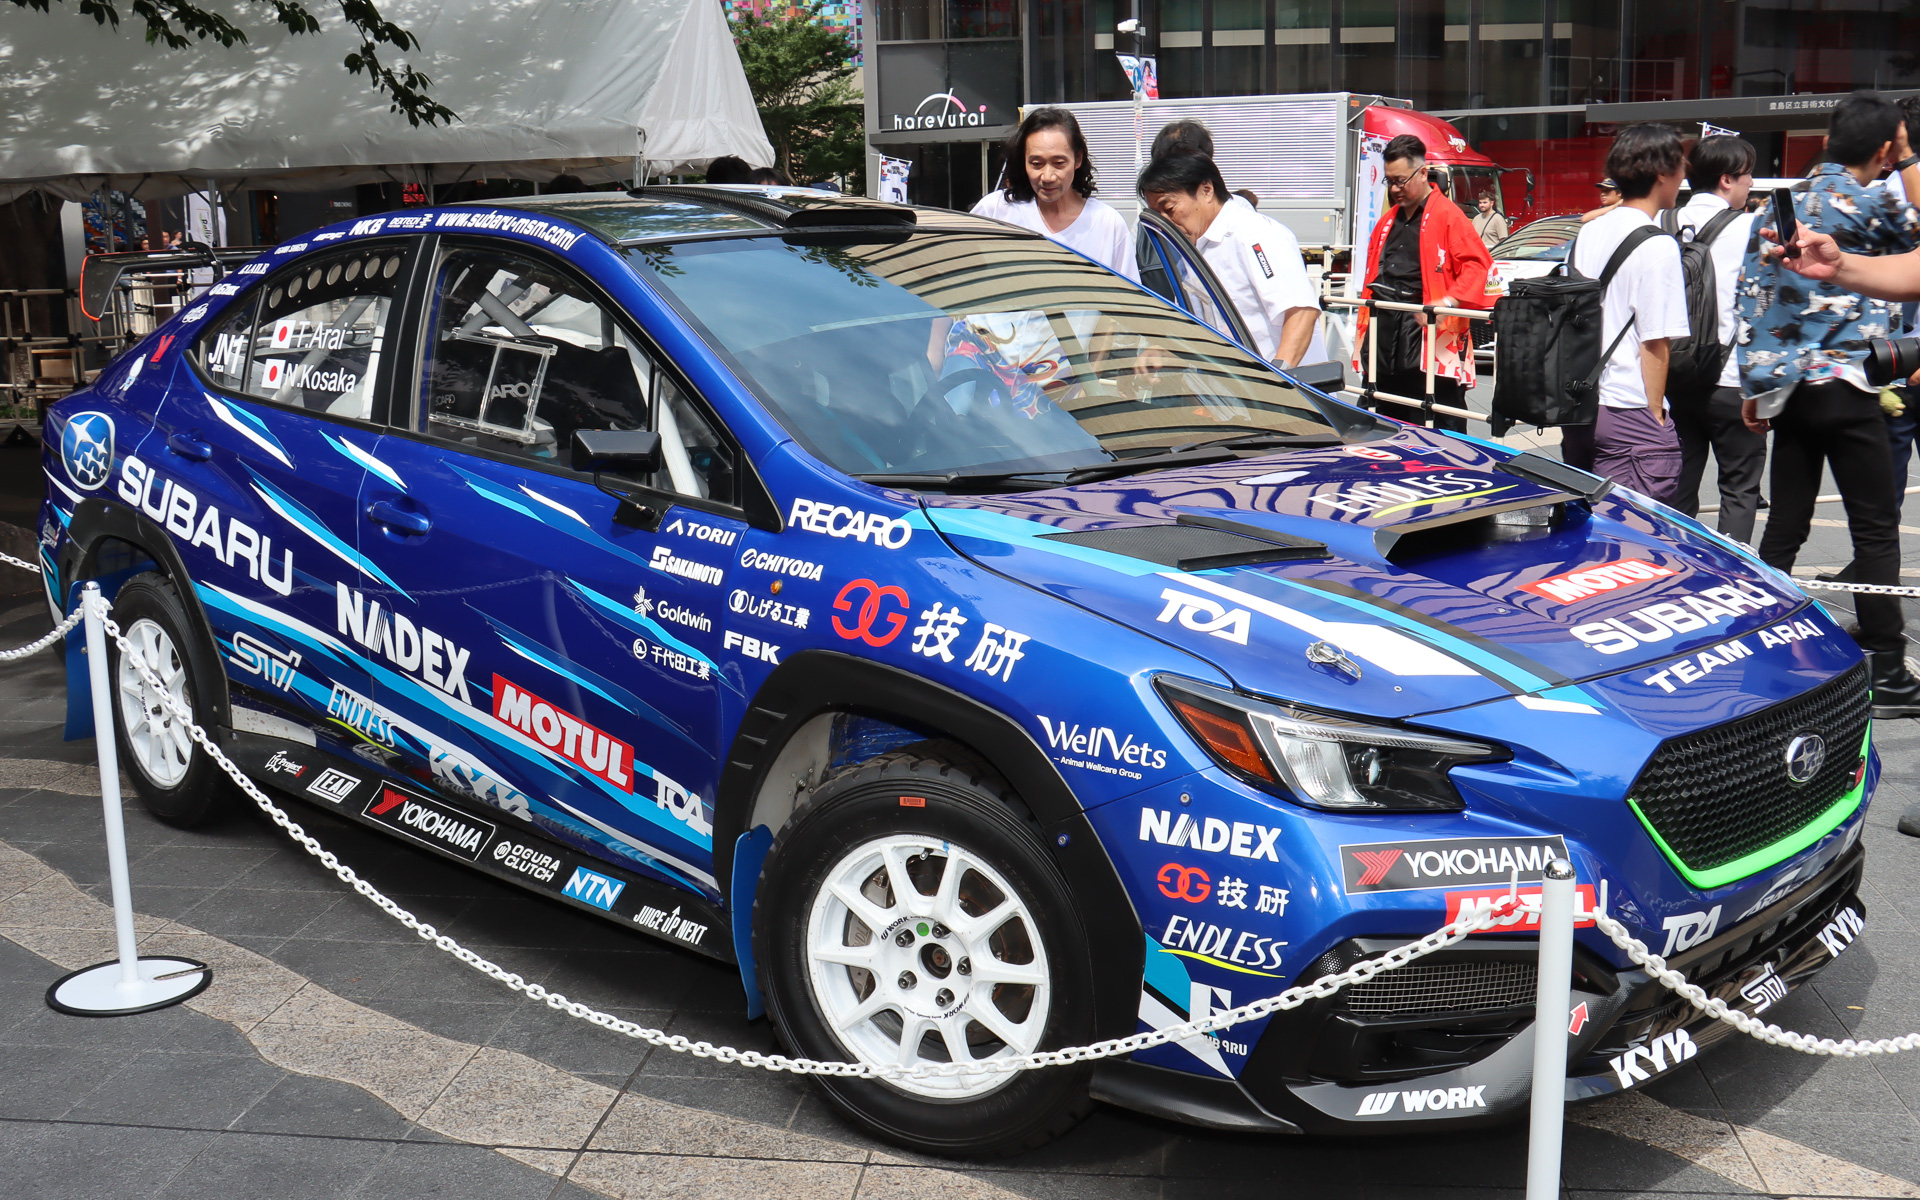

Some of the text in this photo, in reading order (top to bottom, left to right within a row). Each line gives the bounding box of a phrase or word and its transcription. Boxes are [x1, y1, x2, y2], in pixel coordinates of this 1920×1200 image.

[349, 218, 386, 235] NKB
[435, 200, 586, 251] www.subaru-msm.com/
[208, 333, 244, 374] JN1
[297, 320, 348, 350] T.Arai
[286, 362, 357, 393] N.Kosaka
[1307, 472, 1494, 515] ENDLESS
[118, 455, 292, 597] SUBARU
[687, 521, 736, 546] TORII
[788, 498, 912, 549] RECARO
[664, 555, 724, 586] SAKAMOTO
[755, 553, 824, 581] CHIYODA
[1536, 560, 1674, 602] MOTUL
[657, 600, 712, 633] Goldwin
[749, 595, 811, 630] しげる工業
[1155, 587, 1252, 646] TOA
[1569, 579, 1778, 655] SUBARU
[337, 580, 472, 706] NADEX
[650, 646, 711, 681] 千代田工業
[723, 630, 781, 665] FBK
[1644, 618, 1825, 694] TEAM ARAI
[326, 683, 399, 749] ENDLESS
[498, 683, 628, 787] MOTUL
[1036, 714, 1167, 770] WellVets
[312, 771, 355, 798] LEAD
[1060, 756, 1142, 780] Animal Wellcare Group
[652, 769, 713, 838] TOA
[398, 803, 484, 853] YOKOHAMA
[1139, 806, 1282, 863] NADEX
[504, 855, 554, 883] CLUTCH
[512, 844, 561, 872] OGURA
[1403, 845, 1557, 878] YOKOHAMA
[565, 868, 623, 908] NTN
[633, 905, 708, 945] JUICE UP NEXT
[886, 916, 910, 932] WORK
[1161, 914, 1288, 970] ENDLESS
[1662, 905, 1722, 958] TOA
[1816, 906, 1864, 958] KYB
[1608, 1028, 1698, 1089] KYB
[1402, 1084, 1487, 1113] WORK
